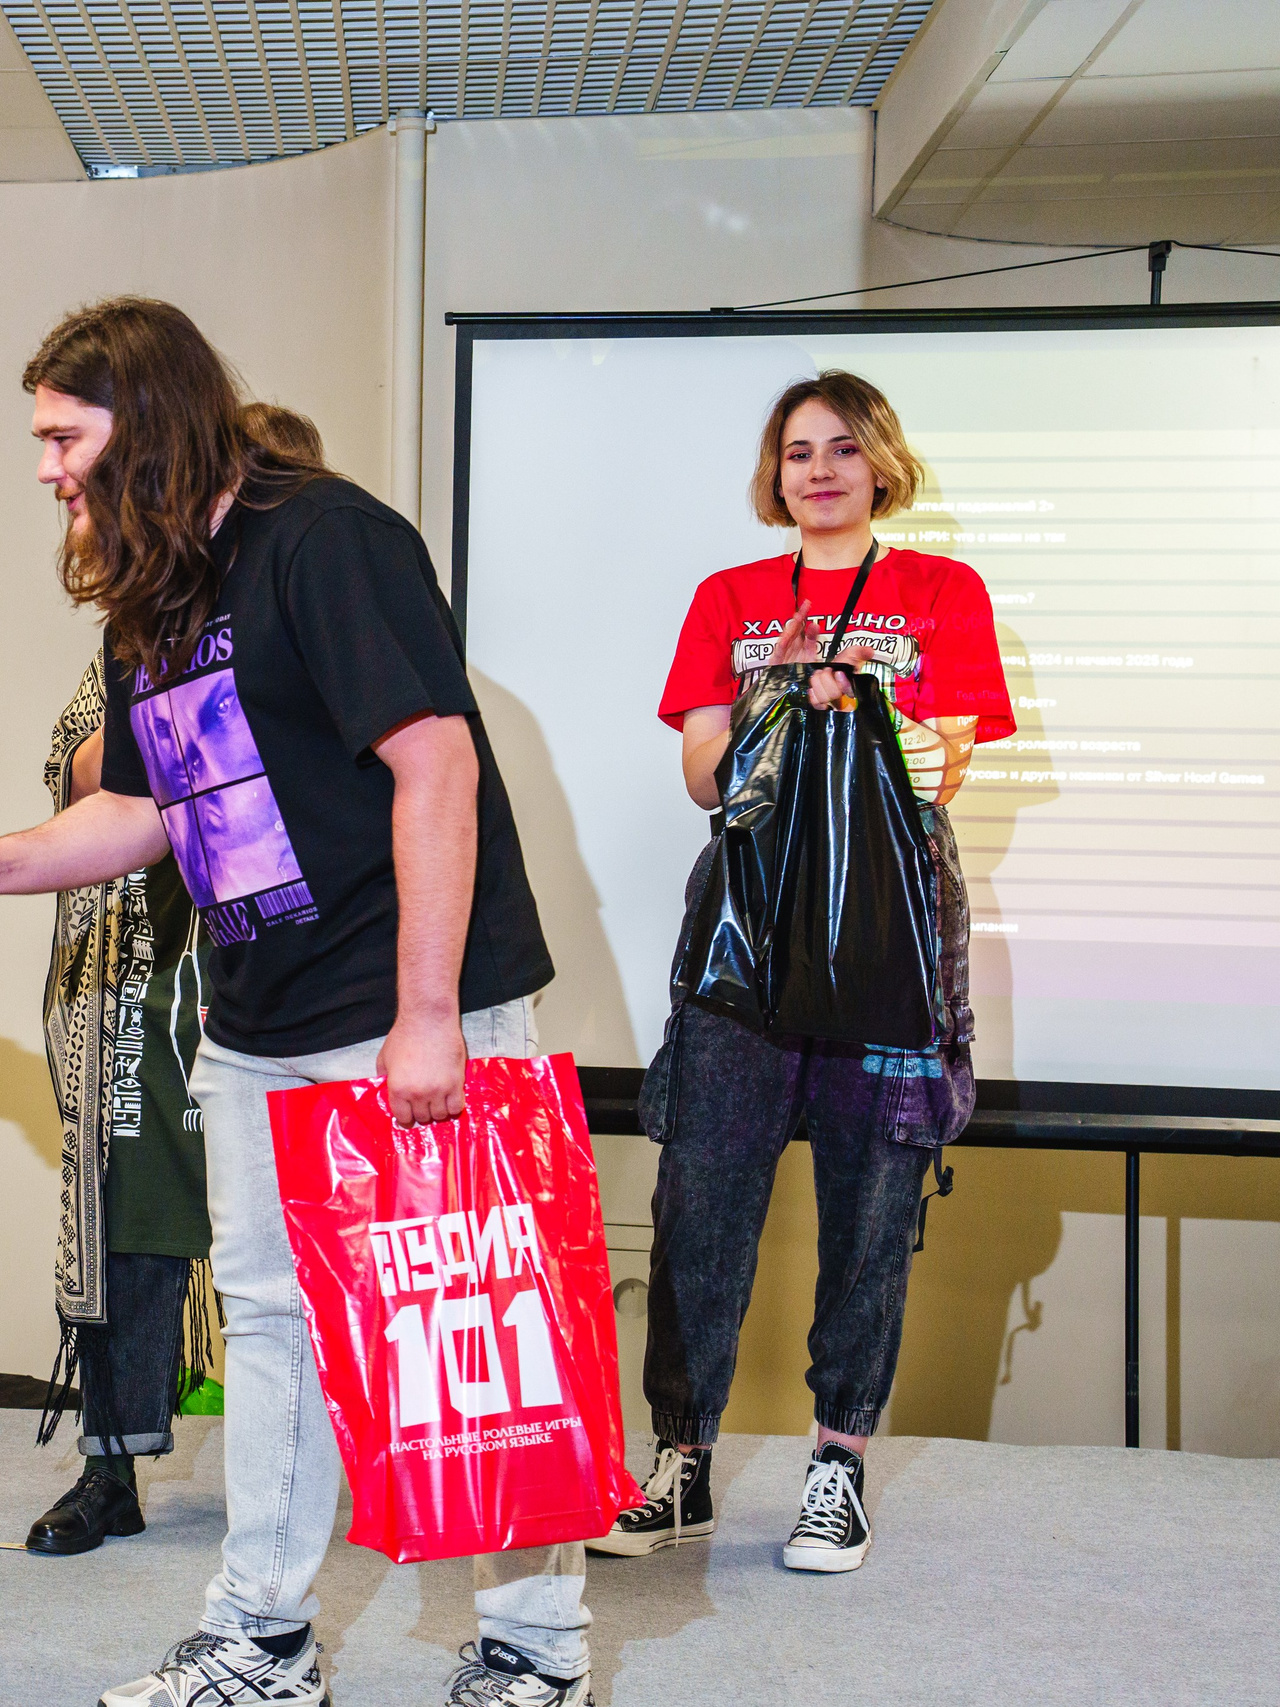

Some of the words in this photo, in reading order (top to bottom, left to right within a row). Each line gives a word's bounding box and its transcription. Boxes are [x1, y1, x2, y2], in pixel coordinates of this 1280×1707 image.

[954, 533, 975, 542] что
[977, 533, 986, 542] с
[1025, 533, 1041, 542] не
[743, 612, 906, 636] ХАТИЧНО
[1029, 653, 1062, 666] 2024
[1076, 656, 1123, 667] начало
[1126, 654, 1159, 666] 2025
[1080, 741, 1141, 752] возраста
[1021, 771, 1067, 782] другие
[1127, 773, 1142, 782] от
[1145, 771, 1182, 783] Silver
[1184, 771, 1216, 783] Hoof
[1219, 772, 1265, 784] Games
[384, 1289, 563, 1428] 101
[390, 1431, 481, 1454] НАСТОЛЬНЫЕ
[483, 1422, 544, 1441] РОЛЕВЫЕ
[545, 1416, 582, 1432] ИГРЫ
[423, 1449, 443, 1461] НА
[445, 1440, 507, 1458] РУССКОМ
[509, 1432, 554, 1448] ЯЗЫКЕ
